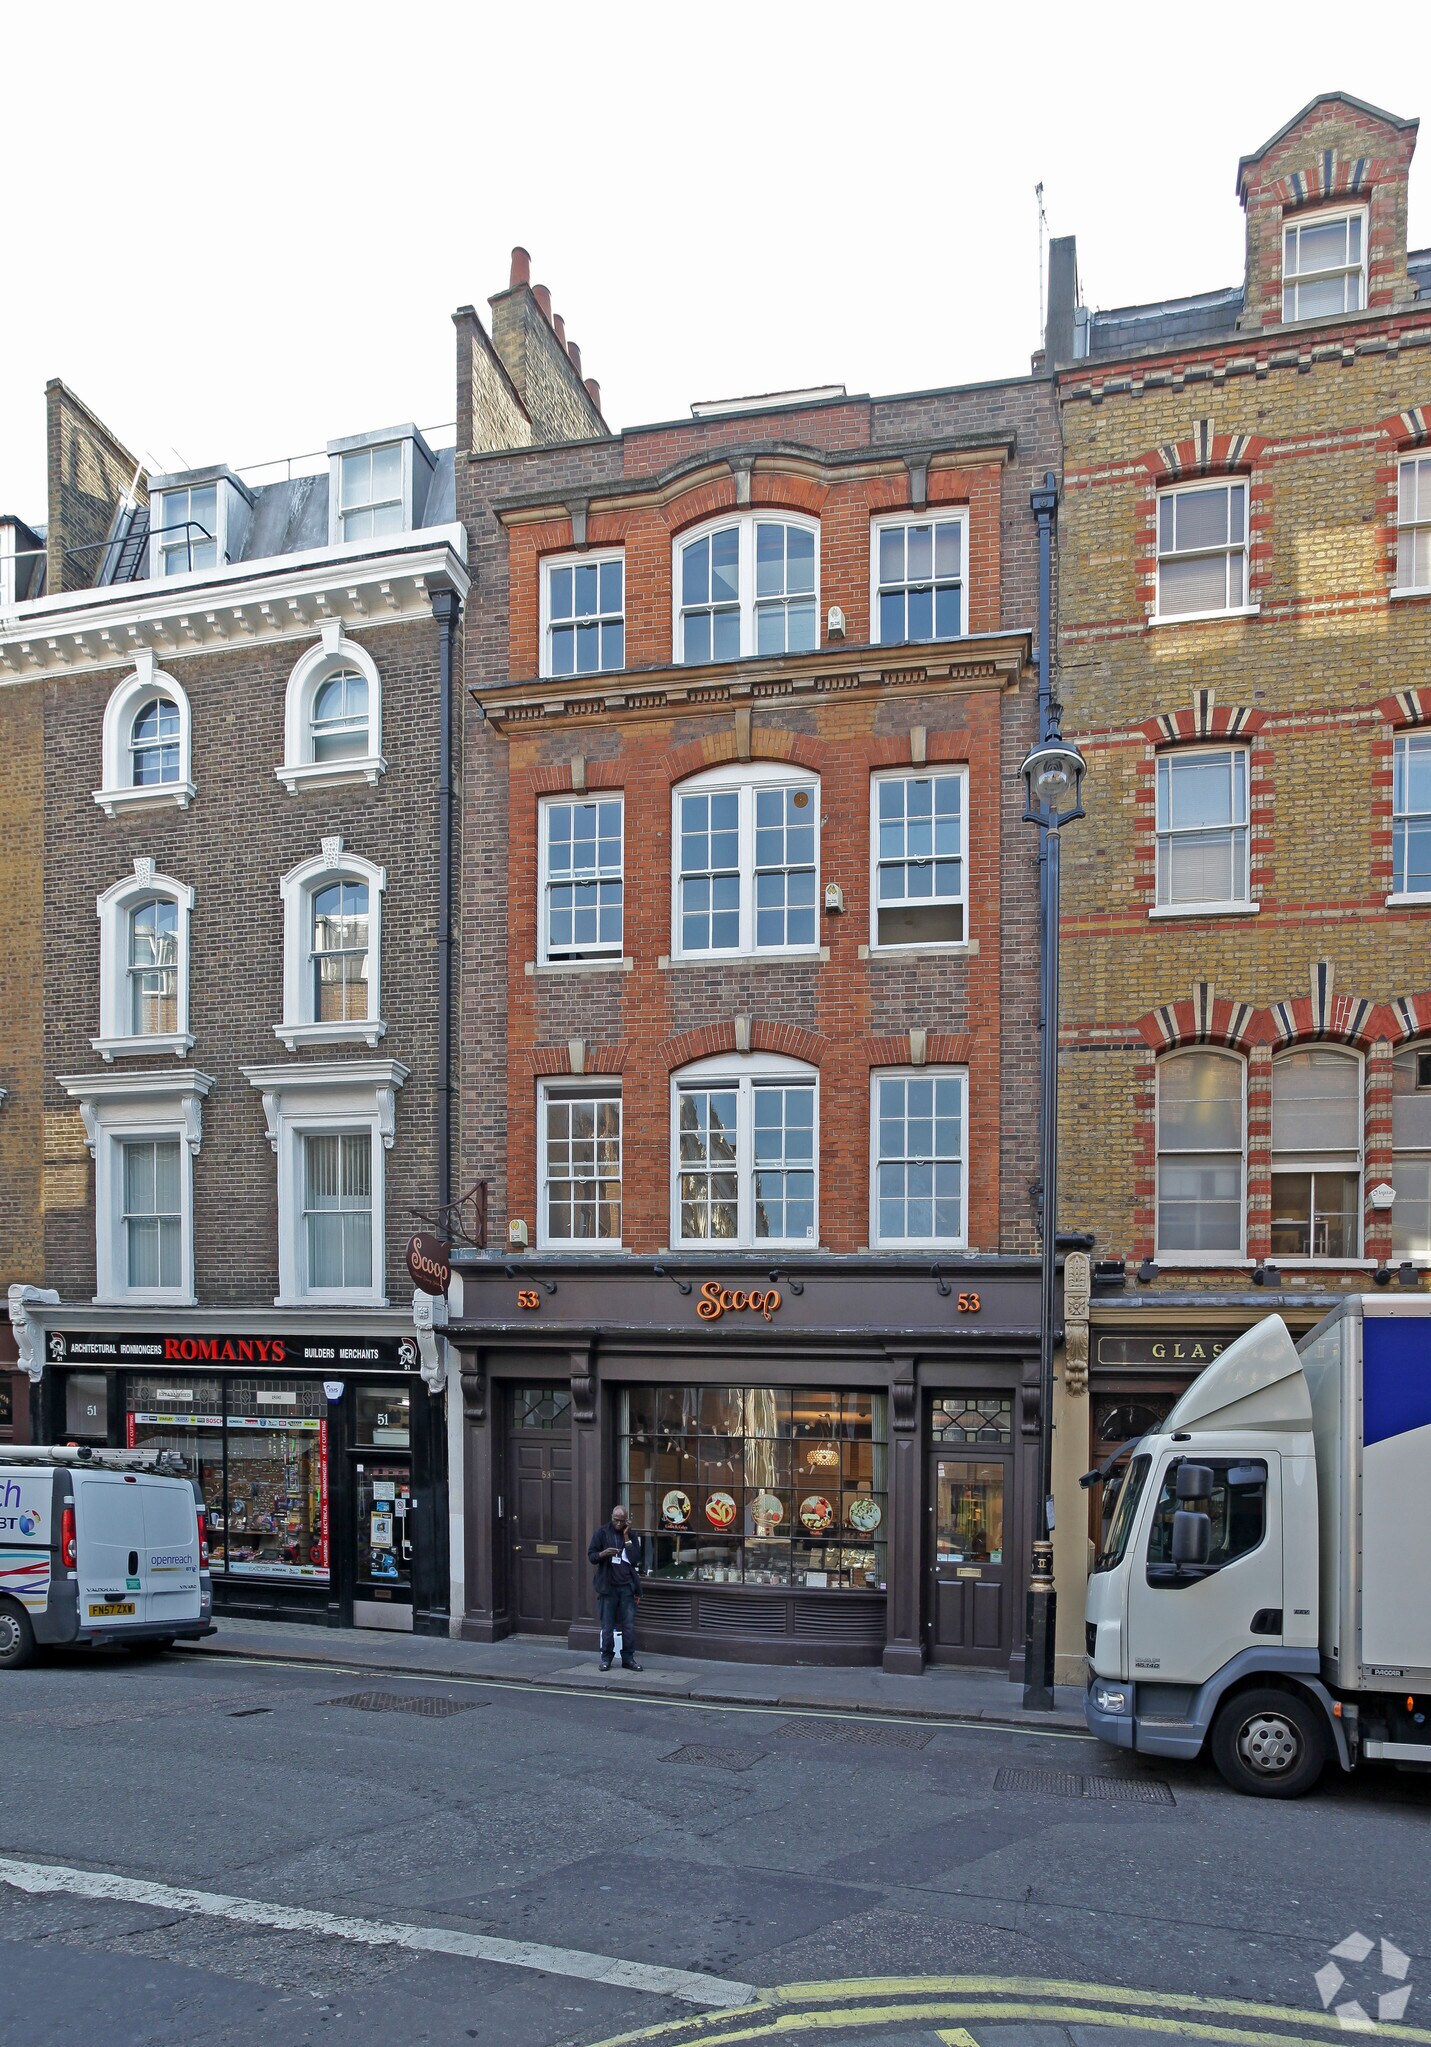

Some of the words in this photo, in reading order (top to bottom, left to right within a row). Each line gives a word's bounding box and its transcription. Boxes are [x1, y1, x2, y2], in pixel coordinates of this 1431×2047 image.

[411, 1237, 448, 1292] Scoop
[517, 1290, 540, 1310] 53
[696, 1281, 782, 1322] Scoop
[957, 1292, 981, 1313] 53
[70, 1343, 117, 1354] ARCHITECTURAL
[120, 1344, 162, 1355] IRONMONGERS
[164, 1338, 285, 1362] ROMANYS
[304, 1348, 335, 1359] BUILDERS
[339, 1348, 379, 1359] MERCHANTS
[86, 1405, 97, 1416] 51
[377, 1413, 389, 1426] 51
[151, 1555, 193, 1566] openreach
[93, 1604, 115, 1615] FN57
[1374, 1669, 1401, 1677] PACCAR
